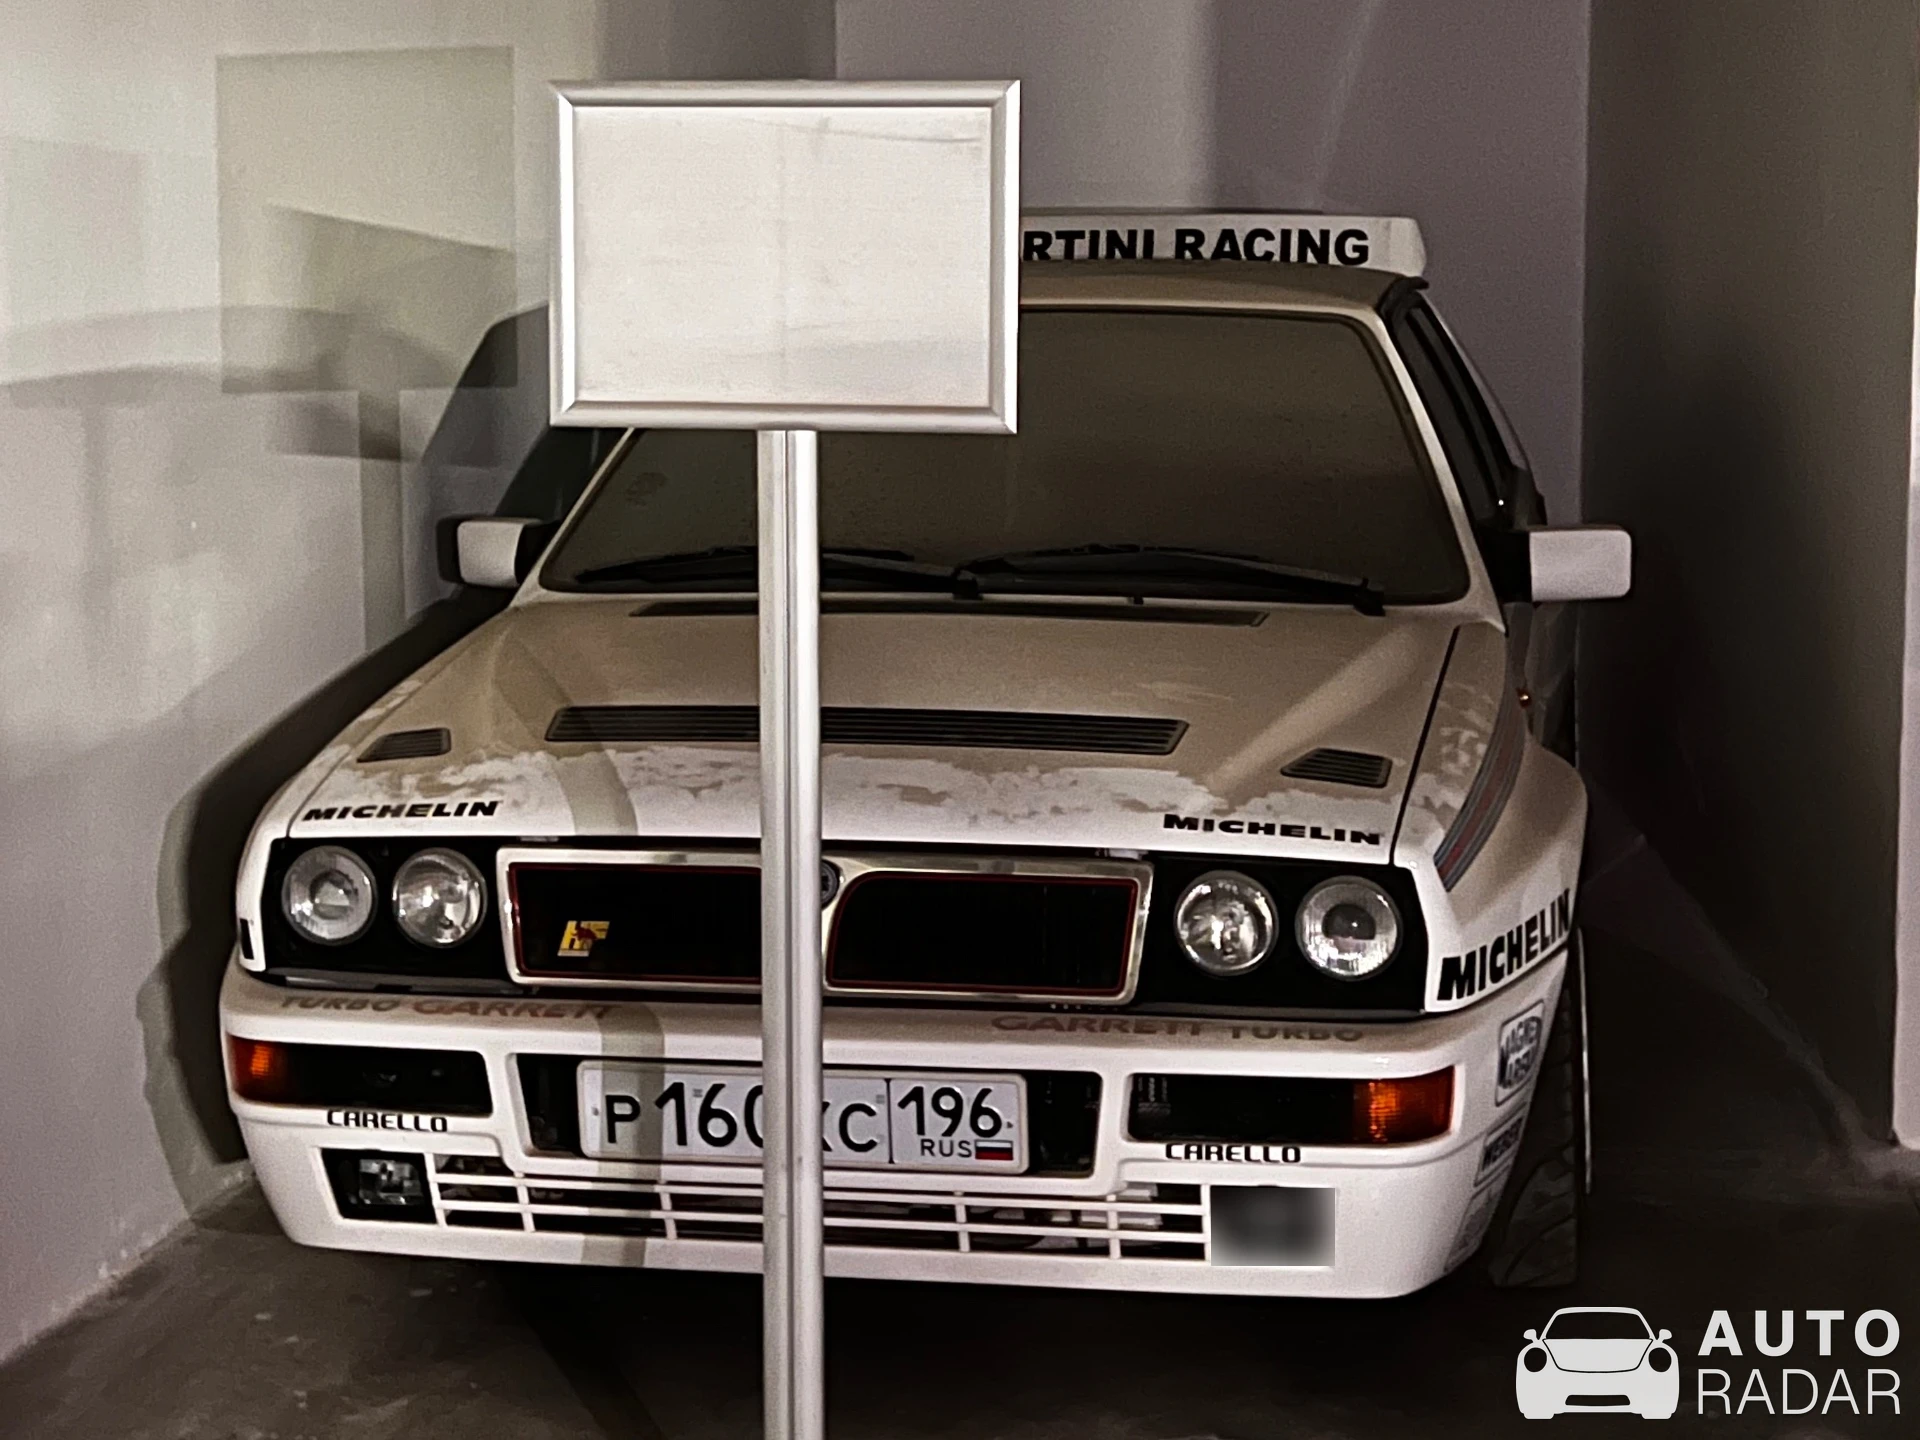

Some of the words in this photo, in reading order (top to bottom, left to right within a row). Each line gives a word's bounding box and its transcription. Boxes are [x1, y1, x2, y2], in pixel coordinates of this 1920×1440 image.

[1175, 228, 1369, 266] RACING
[302, 801, 500, 821] MICHELIN
[1163, 813, 1381, 846] MICHELIN
[1437, 887, 1570, 1001] MICHELIN
[281, 996, 399, 1013] TURBO
[412, 1000, 622, 1019] GARRETT
[991, 1015, 1206, 1036] GARRETT
[1228, 1025, 1364, 1042] TURBO
[327, 1109, 448, 1133] CARELLO
[897, 1086, 1003, 1138] 196
[920, 1138, 973, 1158] RUS
[1165, 1143, 1301, 1163] CARELLO
